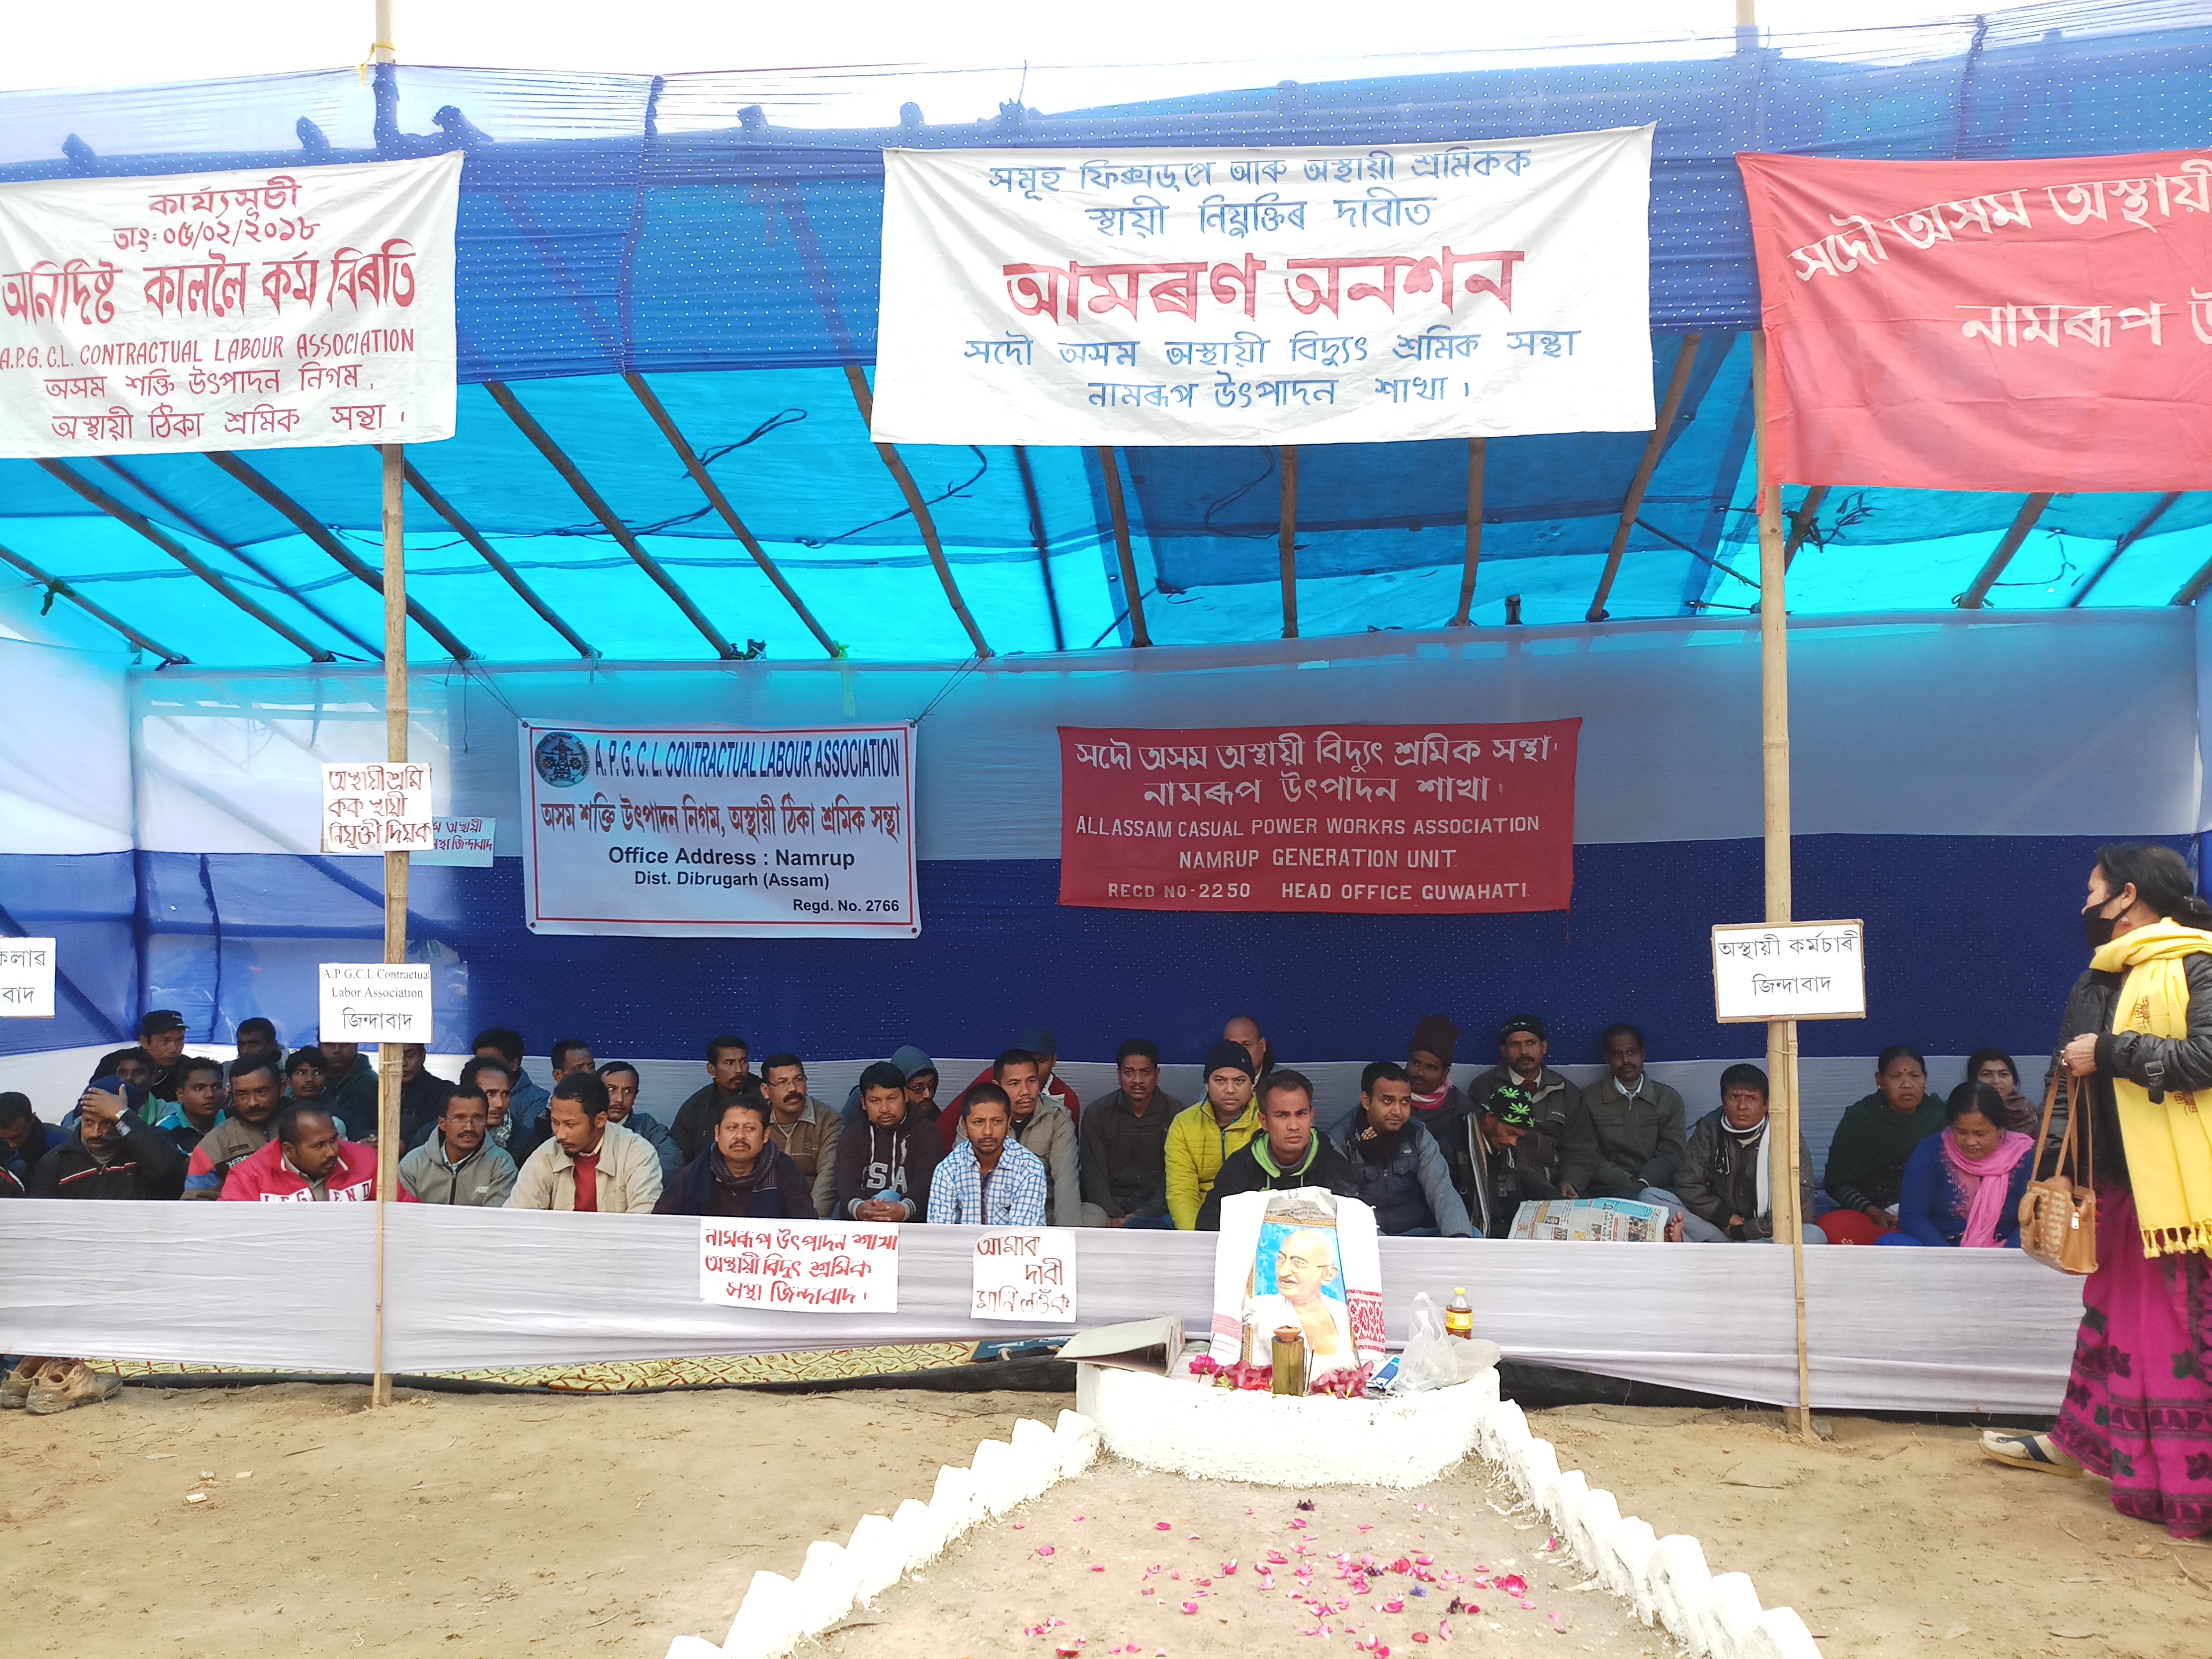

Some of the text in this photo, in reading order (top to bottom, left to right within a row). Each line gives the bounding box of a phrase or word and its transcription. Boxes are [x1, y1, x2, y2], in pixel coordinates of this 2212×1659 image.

[989, 167, 1065, 201] সমূহ
[1231, 160, 1287, 184] আৰু
[1085, 195, 1169, 238] স্থায়ী
[1333, 187, 1437, 228] দাবীত
[1787, 213, 1890, 281] সদৌ
[1885, 189, 2032, 249] অসম
[143, 249, 250, 318] কাললৈ
[327, 238, 416, 311] বিৰতি
[1003, 245, 1525, 325] আমৰণ অনশন
[1956, 301, 2168, 349] নামৰূপ
[80, 338, 203, 367] CONTRACTUAL
[214, 334, 283, 361] LABOUR
[297, 328, 414, 359] ASSOCIATION
[965, 331, 1033, 366] সদৌ
[1058, 341, 1140, 367] অসম
[1165, 331, 1270, 368] অস্থায়ী
[44, 376, 107, 400] অসম
[125, 369, 175, 397] শক্তি
[188, 365, 280, 395] উৎপাদন
[1088, 383, 1198, 408] নামৰূপ
[1215, 371, 1339, 408] উৎপাদন
[52, 406, 134, 441] অস্থায়ী
[148, 403, 205, 437] ঠিকা
[666, 741, 757, 778] CONTRACTUAL
[760, 739, 812, 778] LABOUR
[815, 738, 900, 778] ASSOCIATION
[1074, 738, 1131, 770] সদৌ
[1138, 746, 1207, 771] অসম
[1215, 733, 1306, 769] অস্থায়ী
[1144, 778, 1262, 806] নামৰূপ
[1279, 771, 1399, 802] উৎপাদন
[541, 803, 576, 832] অসম
[579, 792, 616, 833] শক্তি
[619, 793, 679, 834] উৎপাদন
[727, 794, 776, 844] অস্থায়ী
[780, 792, 816, 836] ঠিকা
[1178, 820, 1244, 838] CASUAL
[1252, 818, 1318, 835] POWER
[1327, 818, 1406, 835] WORKRS
[609, 846, 669, 864] Office
[675, 848, 756, 865] Address
[776, 849, 855, 870] Namrup
[1179, 849, 1259, 869] NAMRUP
[1273, 848, 1398, 868] GENERATION
[635, 871, 829, 890] Dist. Dibrugarh (Assam)
[1282, 883, 1331, 899] HEAD
[1341, 883, 1412, 900] OFFICE
[793, 899, 899, 914] Regd. No. 2766
[1717, 934, 1781, 960] অস্থায়ী
[332, 987, 423, 998] Labor Association
[377, 969, 430, 980] Contractual
[1752, 974, 1832, 996] জিন্দাবাদ
[341, 1007, 413, 1030] জিন্দাবাদ
